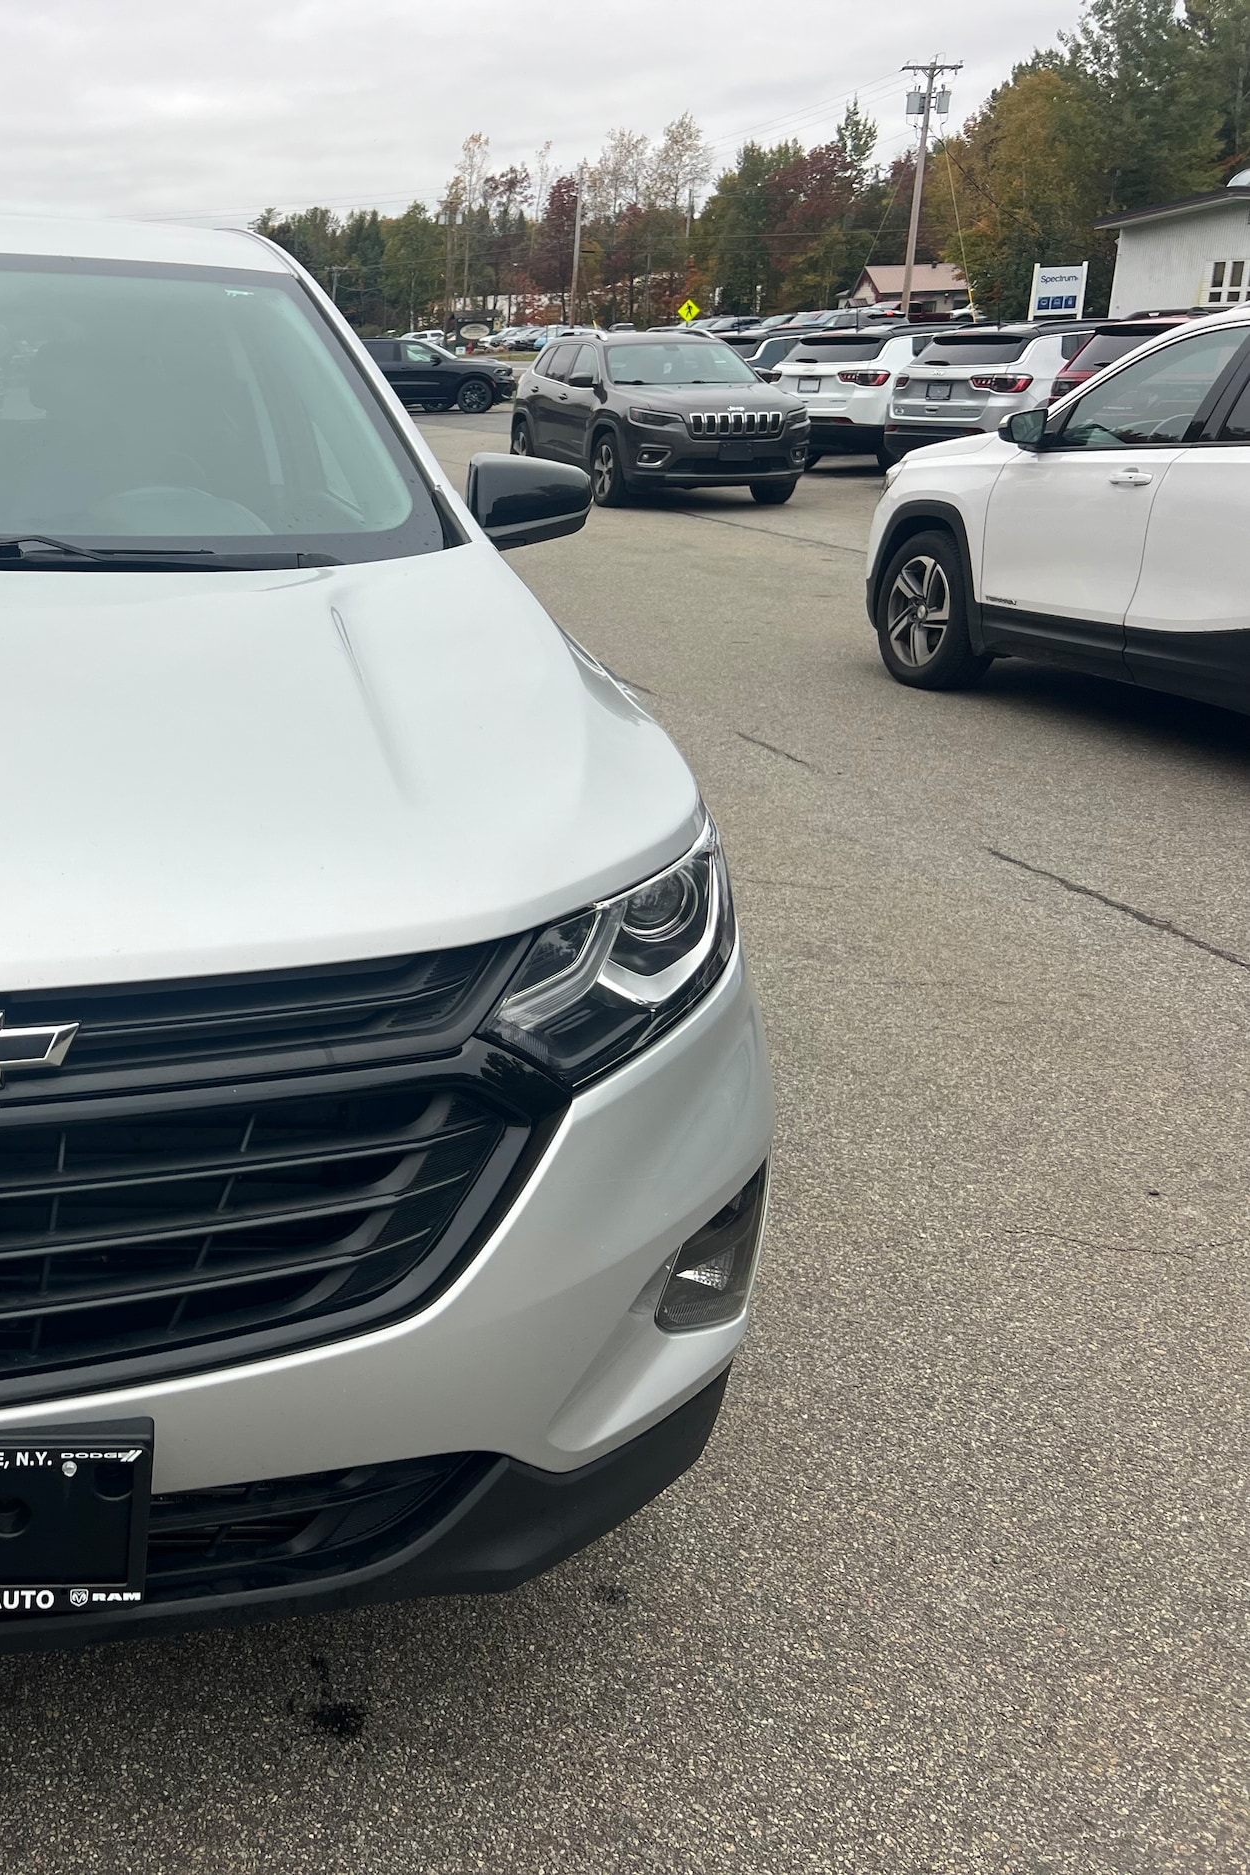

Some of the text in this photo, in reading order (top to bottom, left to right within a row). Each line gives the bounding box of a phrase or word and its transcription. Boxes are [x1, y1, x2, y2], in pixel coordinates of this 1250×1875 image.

[1040, 275, 1077, 284] Spectrum
[16, 1452, 53, 1467] N.Y.
[91, 1592, 141, 1602] RAM
